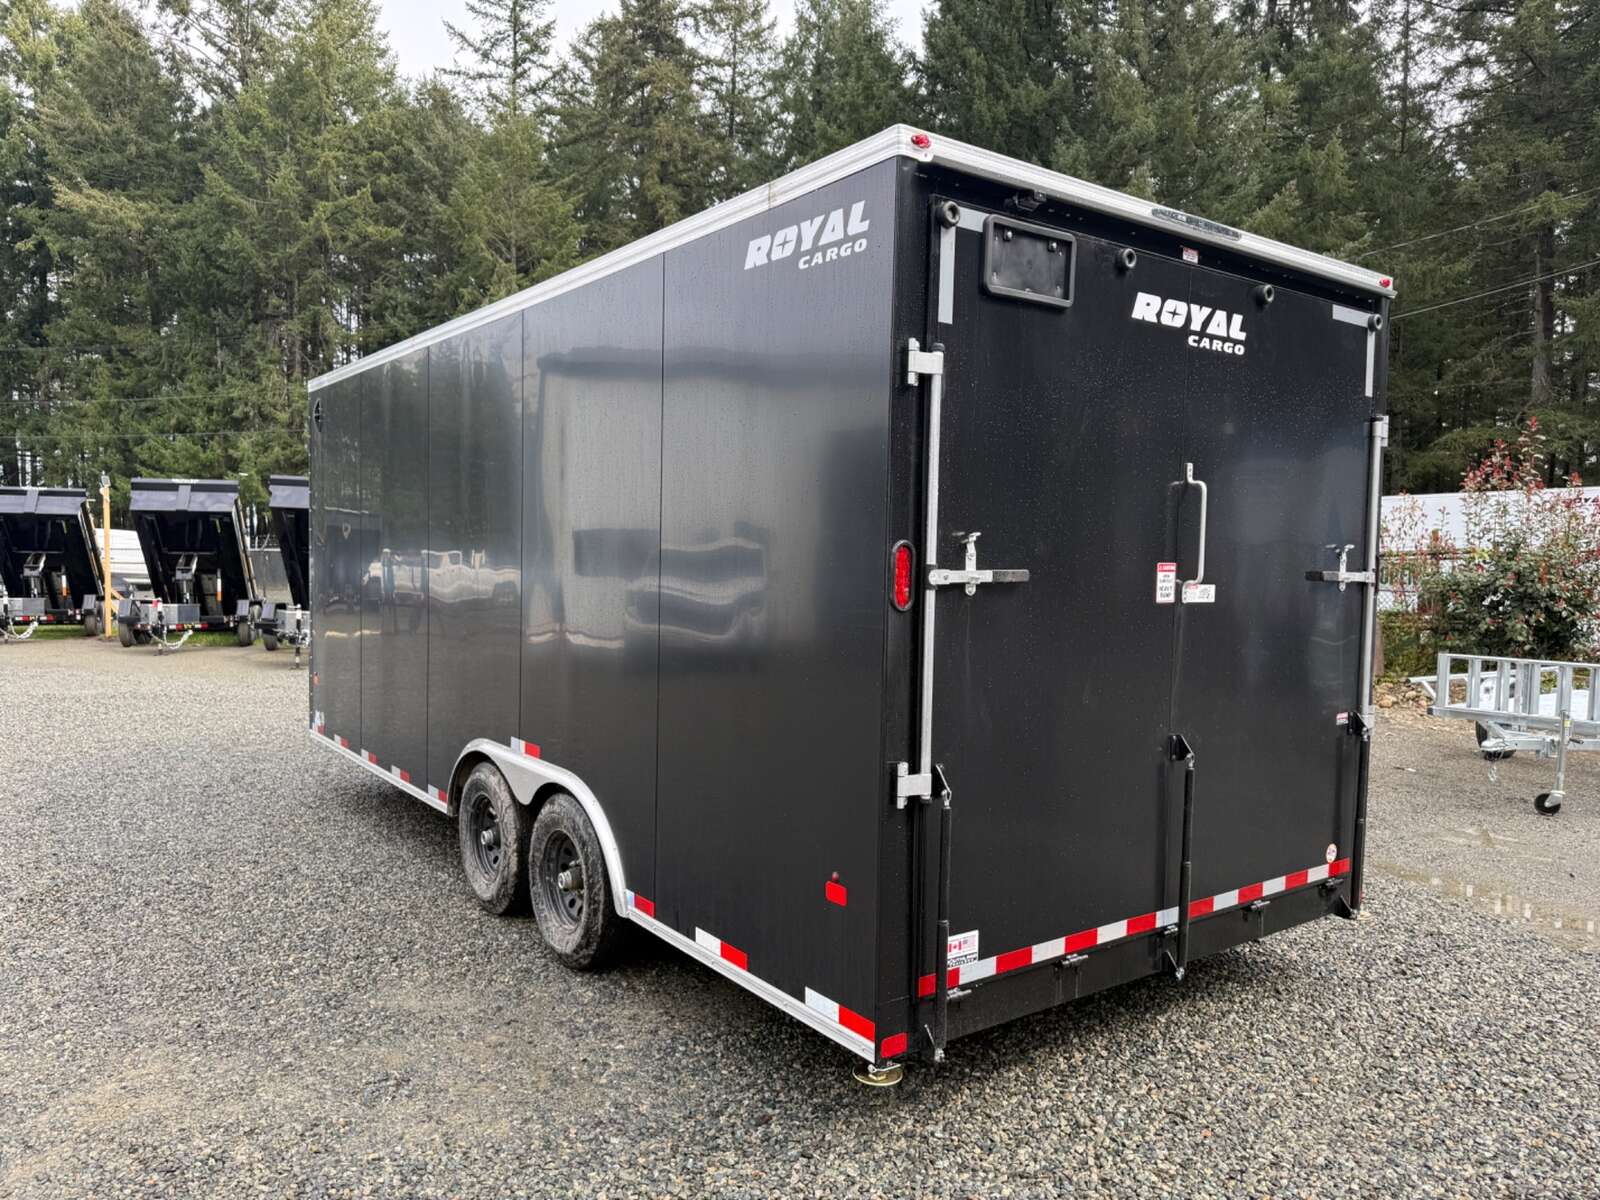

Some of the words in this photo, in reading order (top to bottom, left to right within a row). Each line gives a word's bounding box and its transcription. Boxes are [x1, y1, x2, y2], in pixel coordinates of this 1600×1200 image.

[743, 199, 871, 271] ROYAL
[798, 238, 868, 270] CARGO
[1131, 291, 1247, 341] ROYAL
[1187, 335, 1246, 355] CARGO
